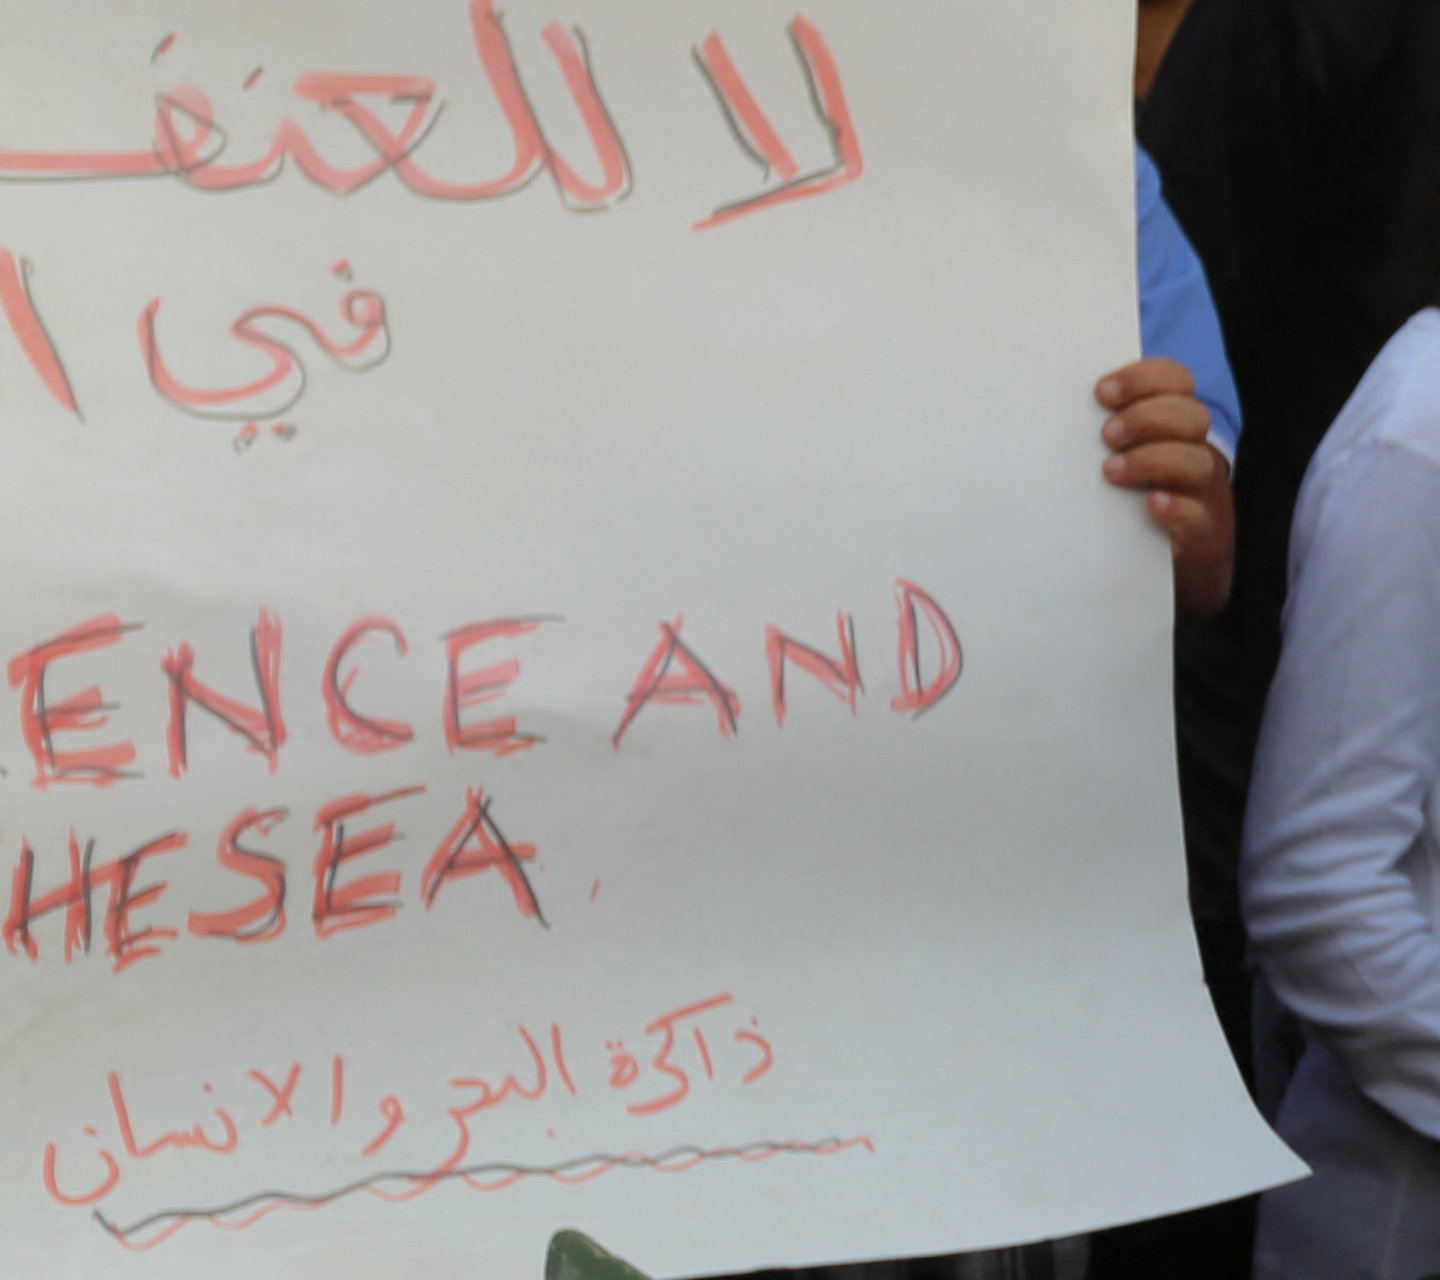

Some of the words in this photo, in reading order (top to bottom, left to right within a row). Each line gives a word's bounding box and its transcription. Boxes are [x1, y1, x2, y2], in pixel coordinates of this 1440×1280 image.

[690, 11, 864, 232] لا
[137, 258, 392, 455] في
[0, 606, 564, 790] ENCE
[611, 577, 964, 751] AND
